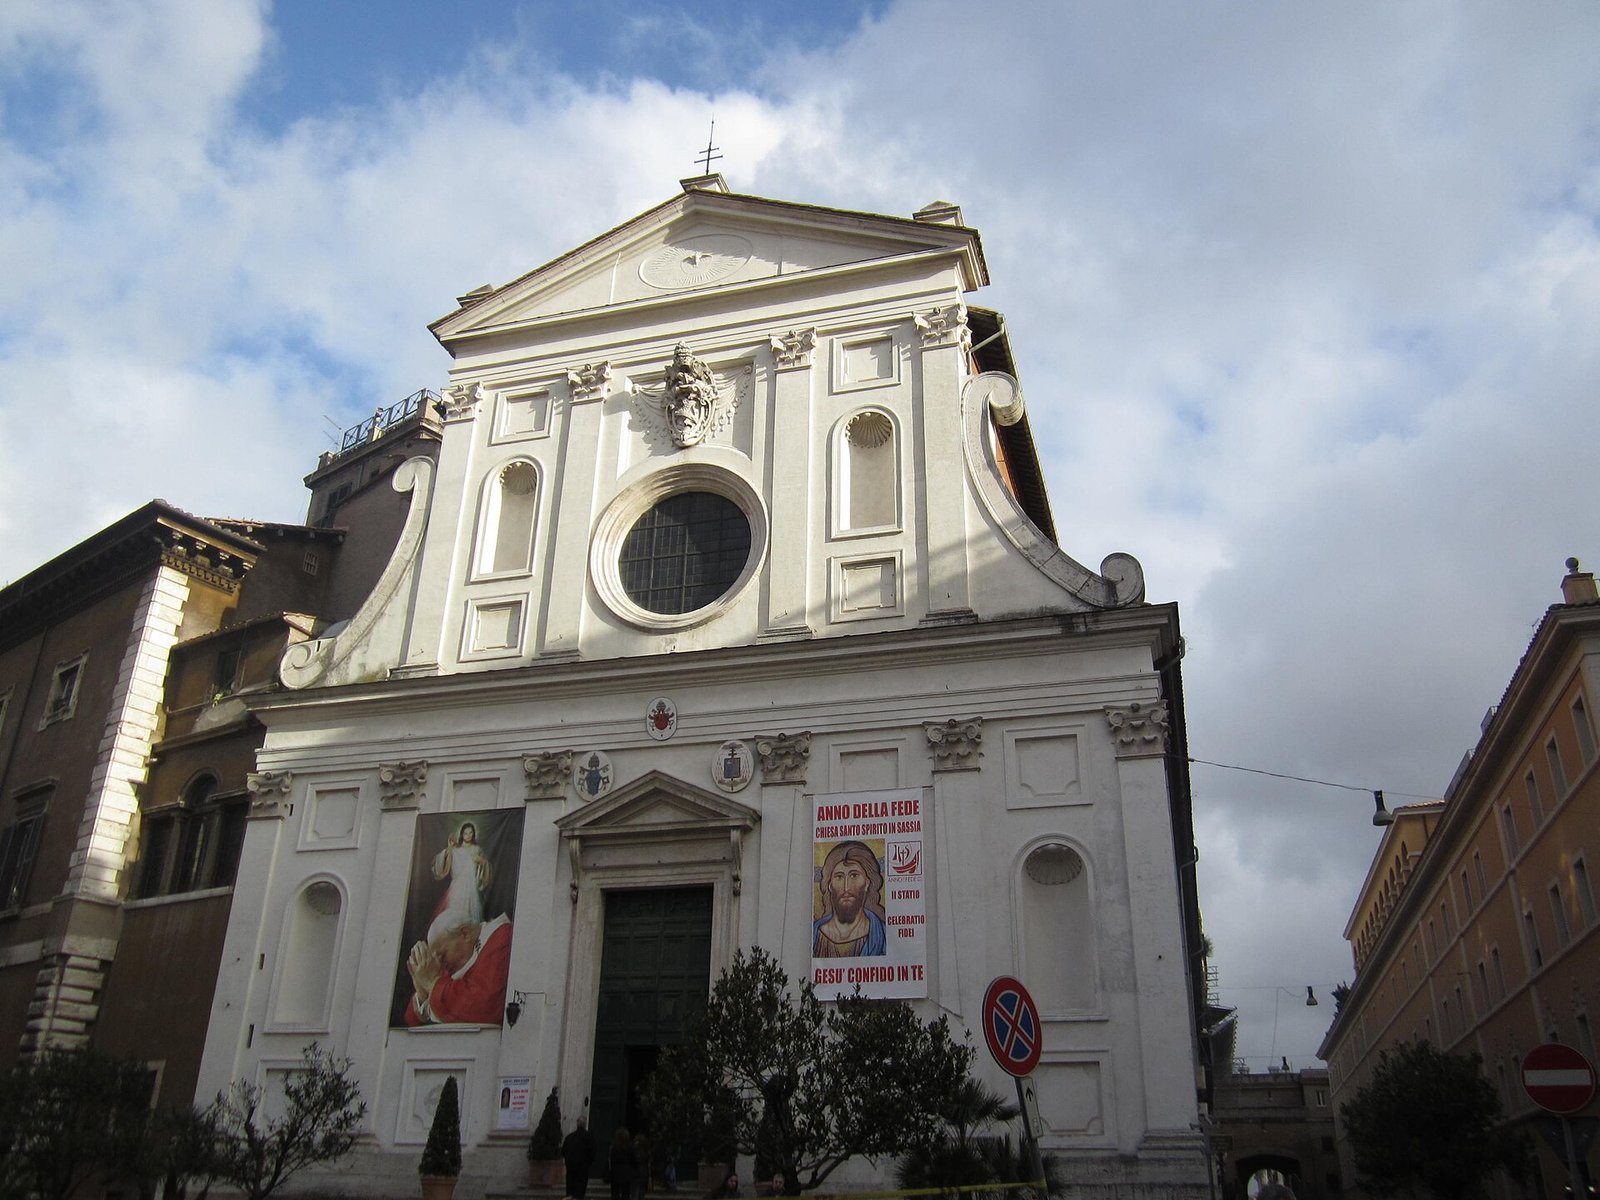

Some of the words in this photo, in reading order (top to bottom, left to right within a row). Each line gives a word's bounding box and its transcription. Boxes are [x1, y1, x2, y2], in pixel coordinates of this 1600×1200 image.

[817, 804, 850, 821] ANNO
[853, 802, 888, 819] DELLA
[891, 800, 920, 816] FEDE
[815, 826, 838, 838] CHIESA
[840, 824, 861, 836] SANTO
[862, 823, 887, 835] SPIRITO
[888, 822, 896, 834] IN
[897, 820, 921, 833] SASSIA
[897, 889, 920, 899] STATIO
[887, 915, 925, 925] CELEBRATIO
[898, 928, 914, 938] FIDEI
[847, 966, 895, 983] CONFIDO
[897, 965, 909, 981] IN
[911, 964, 924, 981] TE
